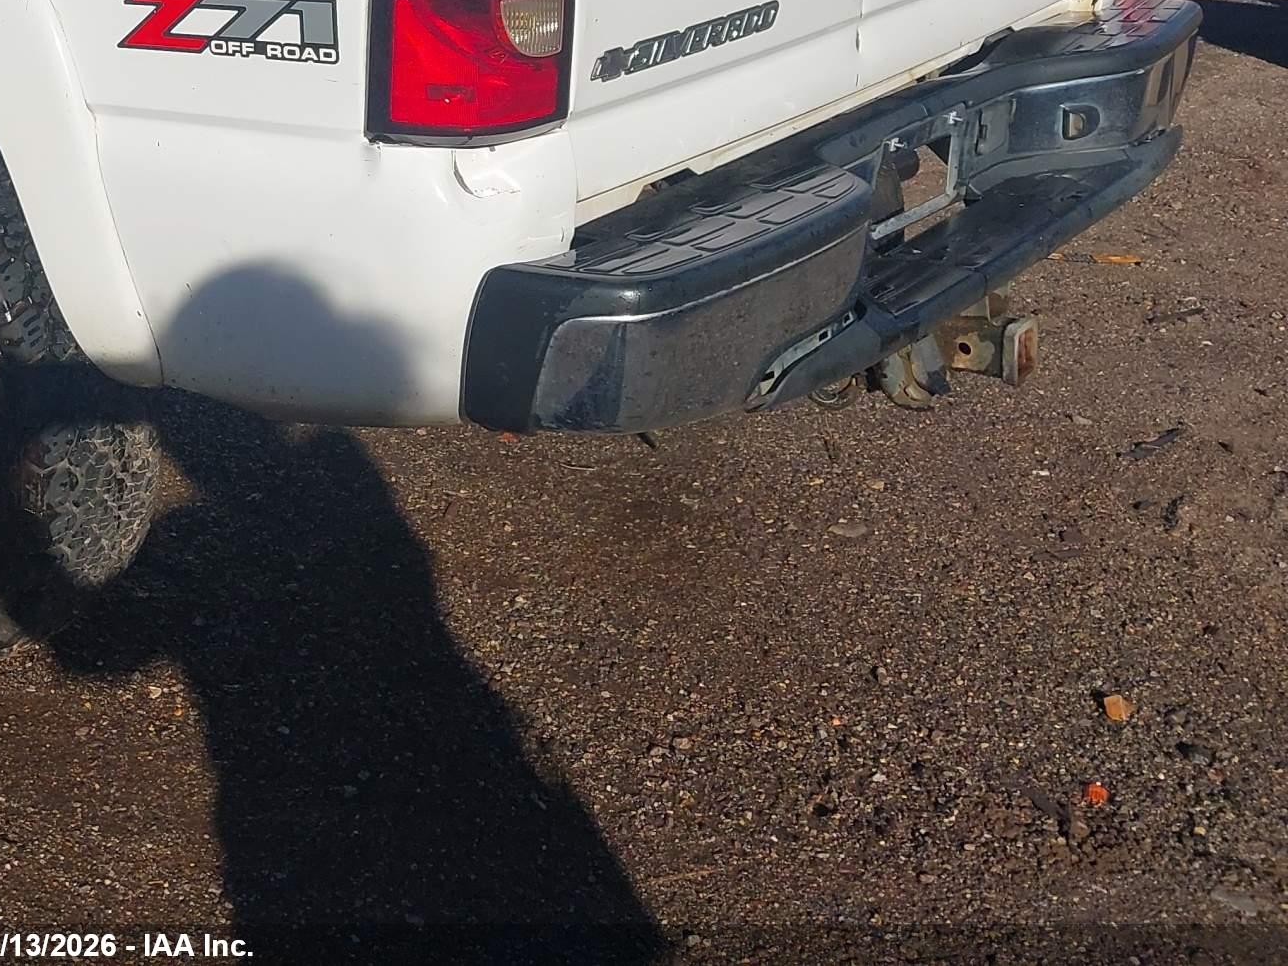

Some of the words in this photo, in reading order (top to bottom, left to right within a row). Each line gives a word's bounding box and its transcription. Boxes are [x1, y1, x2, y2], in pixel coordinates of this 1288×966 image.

[210, 39, 255, 57] OFF
[266, 44, 338, 63] ROAD
[623, 0, 779, 75] SILVERADO
